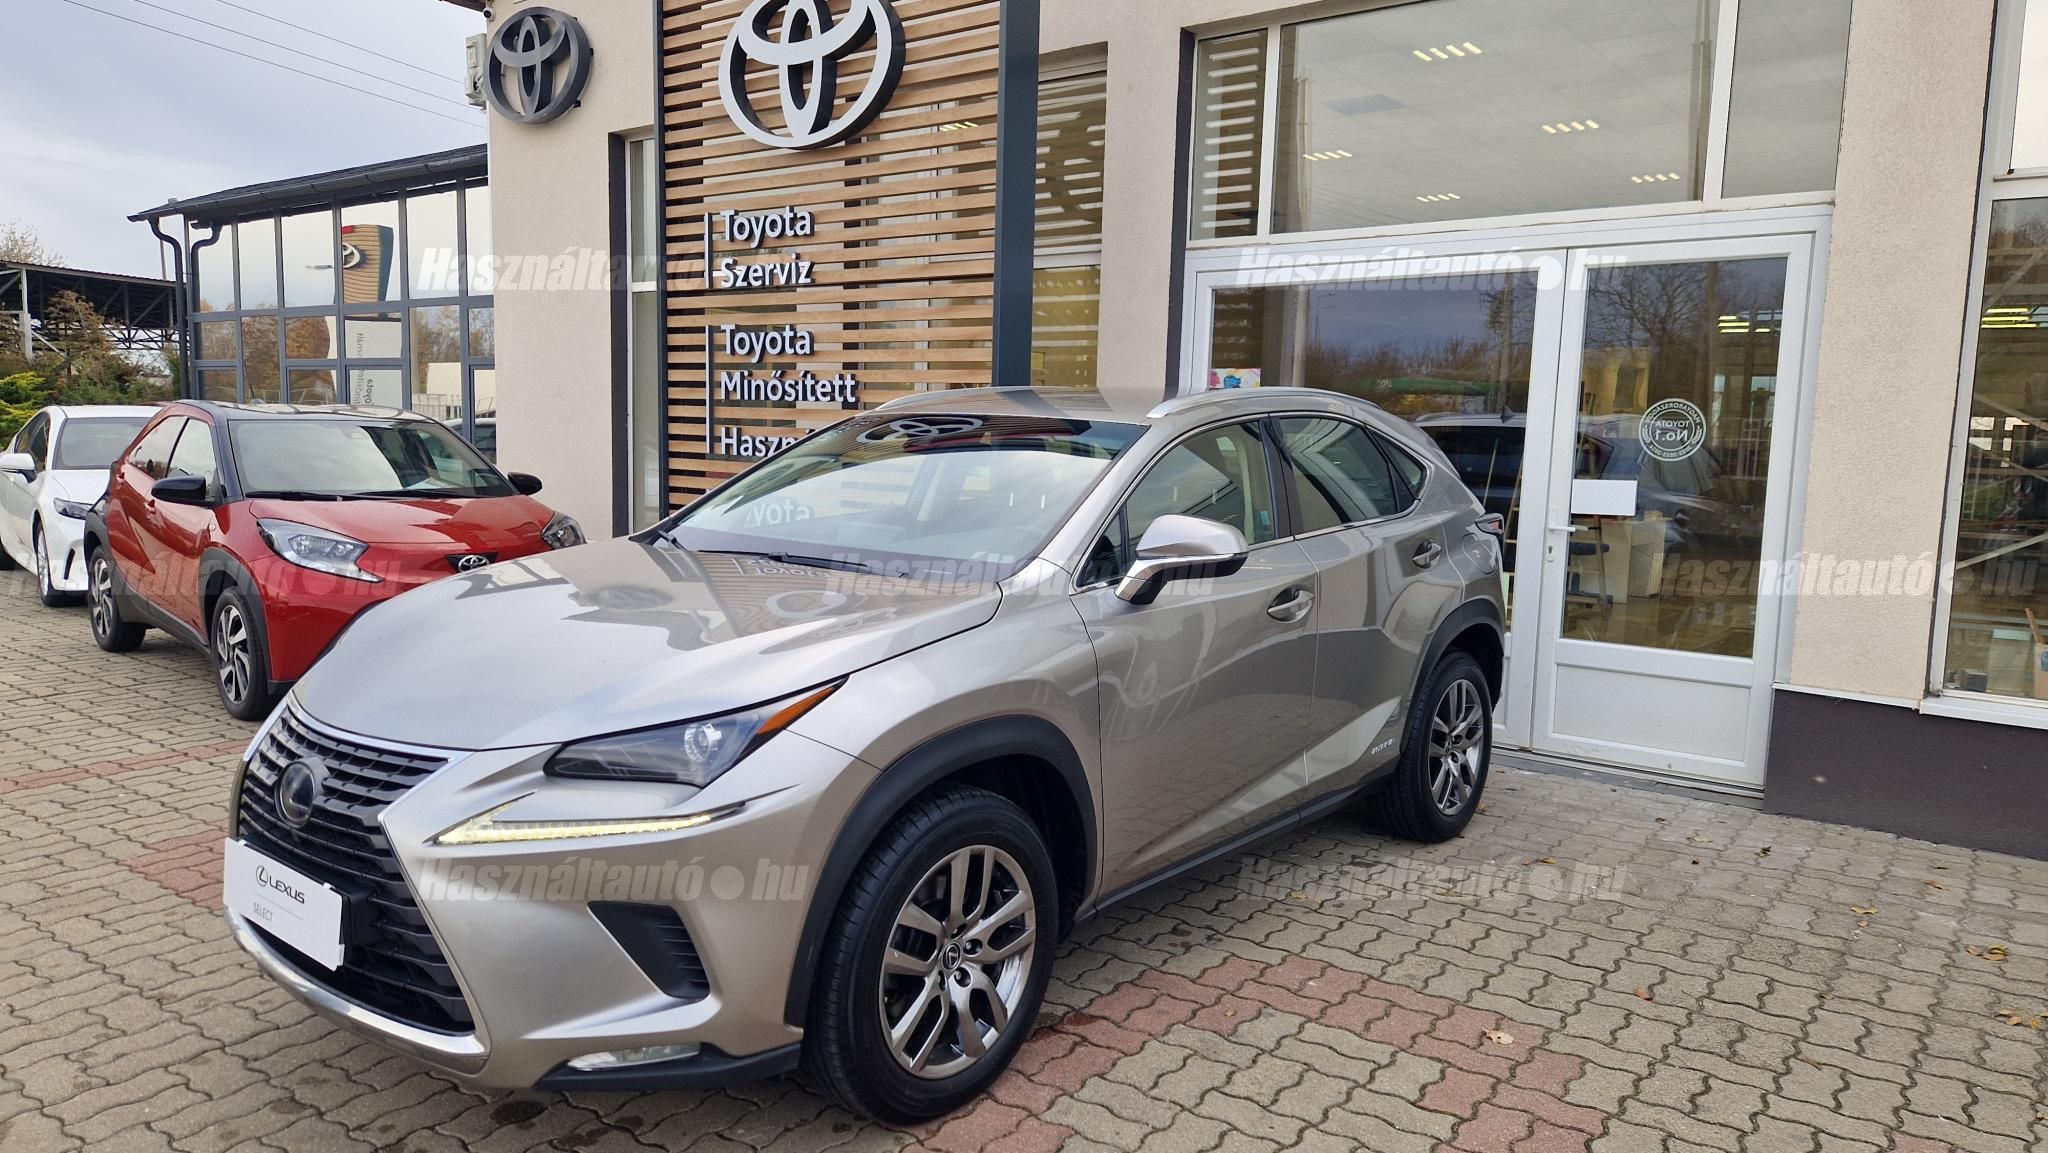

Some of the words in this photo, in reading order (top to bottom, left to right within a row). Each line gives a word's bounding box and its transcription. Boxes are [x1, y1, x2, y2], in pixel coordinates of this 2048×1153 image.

[720, 205, 813, 249] Toyota
[720, 252, 812, 288] Szerviz
[720, 324, 812, 363] Toyota
[720, 369, 858, 403] Minősített
[269, 875, 305, 905] LEXUS
[253, 902, 273, 922] SELECT
